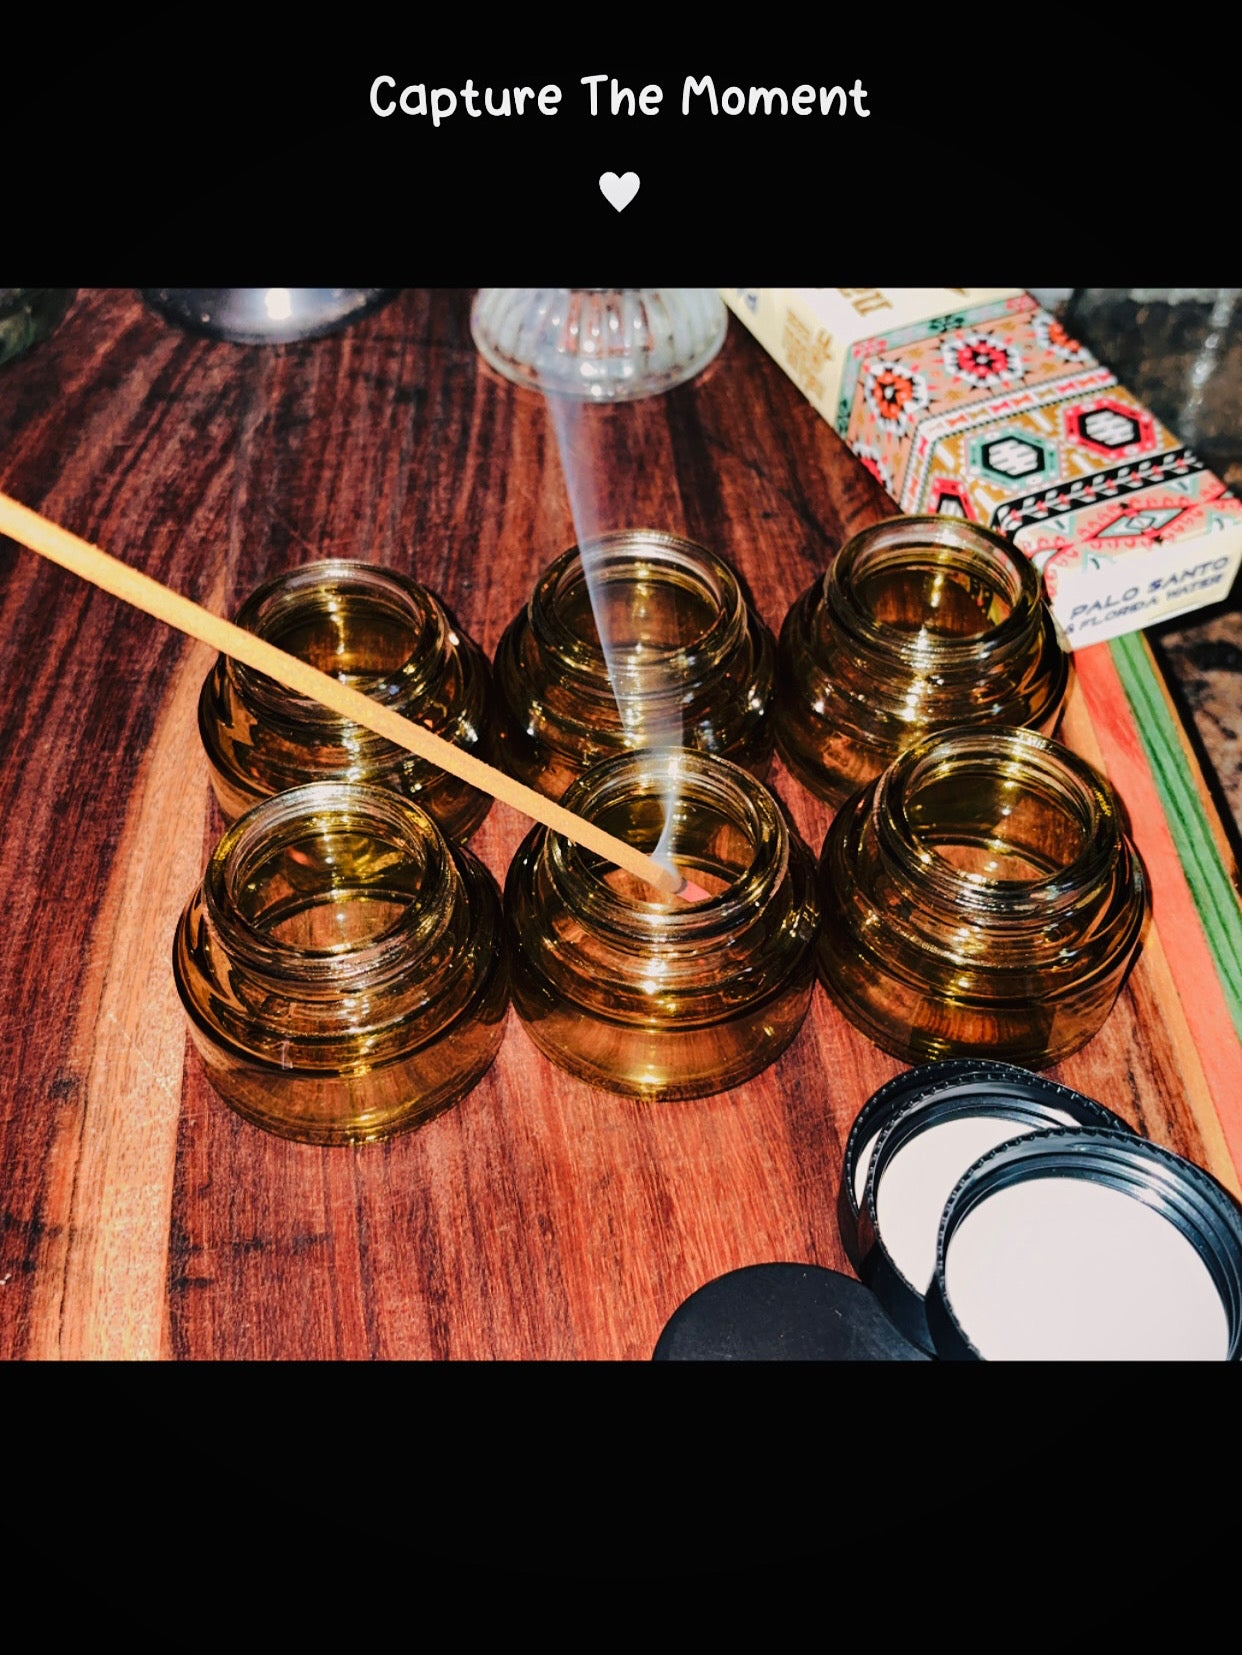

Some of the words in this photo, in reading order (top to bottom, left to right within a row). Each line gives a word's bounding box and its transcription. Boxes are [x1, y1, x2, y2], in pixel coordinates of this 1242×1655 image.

[1070, 587, 1139, 620] PALO
[1147, 557, 1229, 593] SANTO
[1079, 598, 1159, 631] FLORIDA
[1167, 574, 1224, 600] WATER
